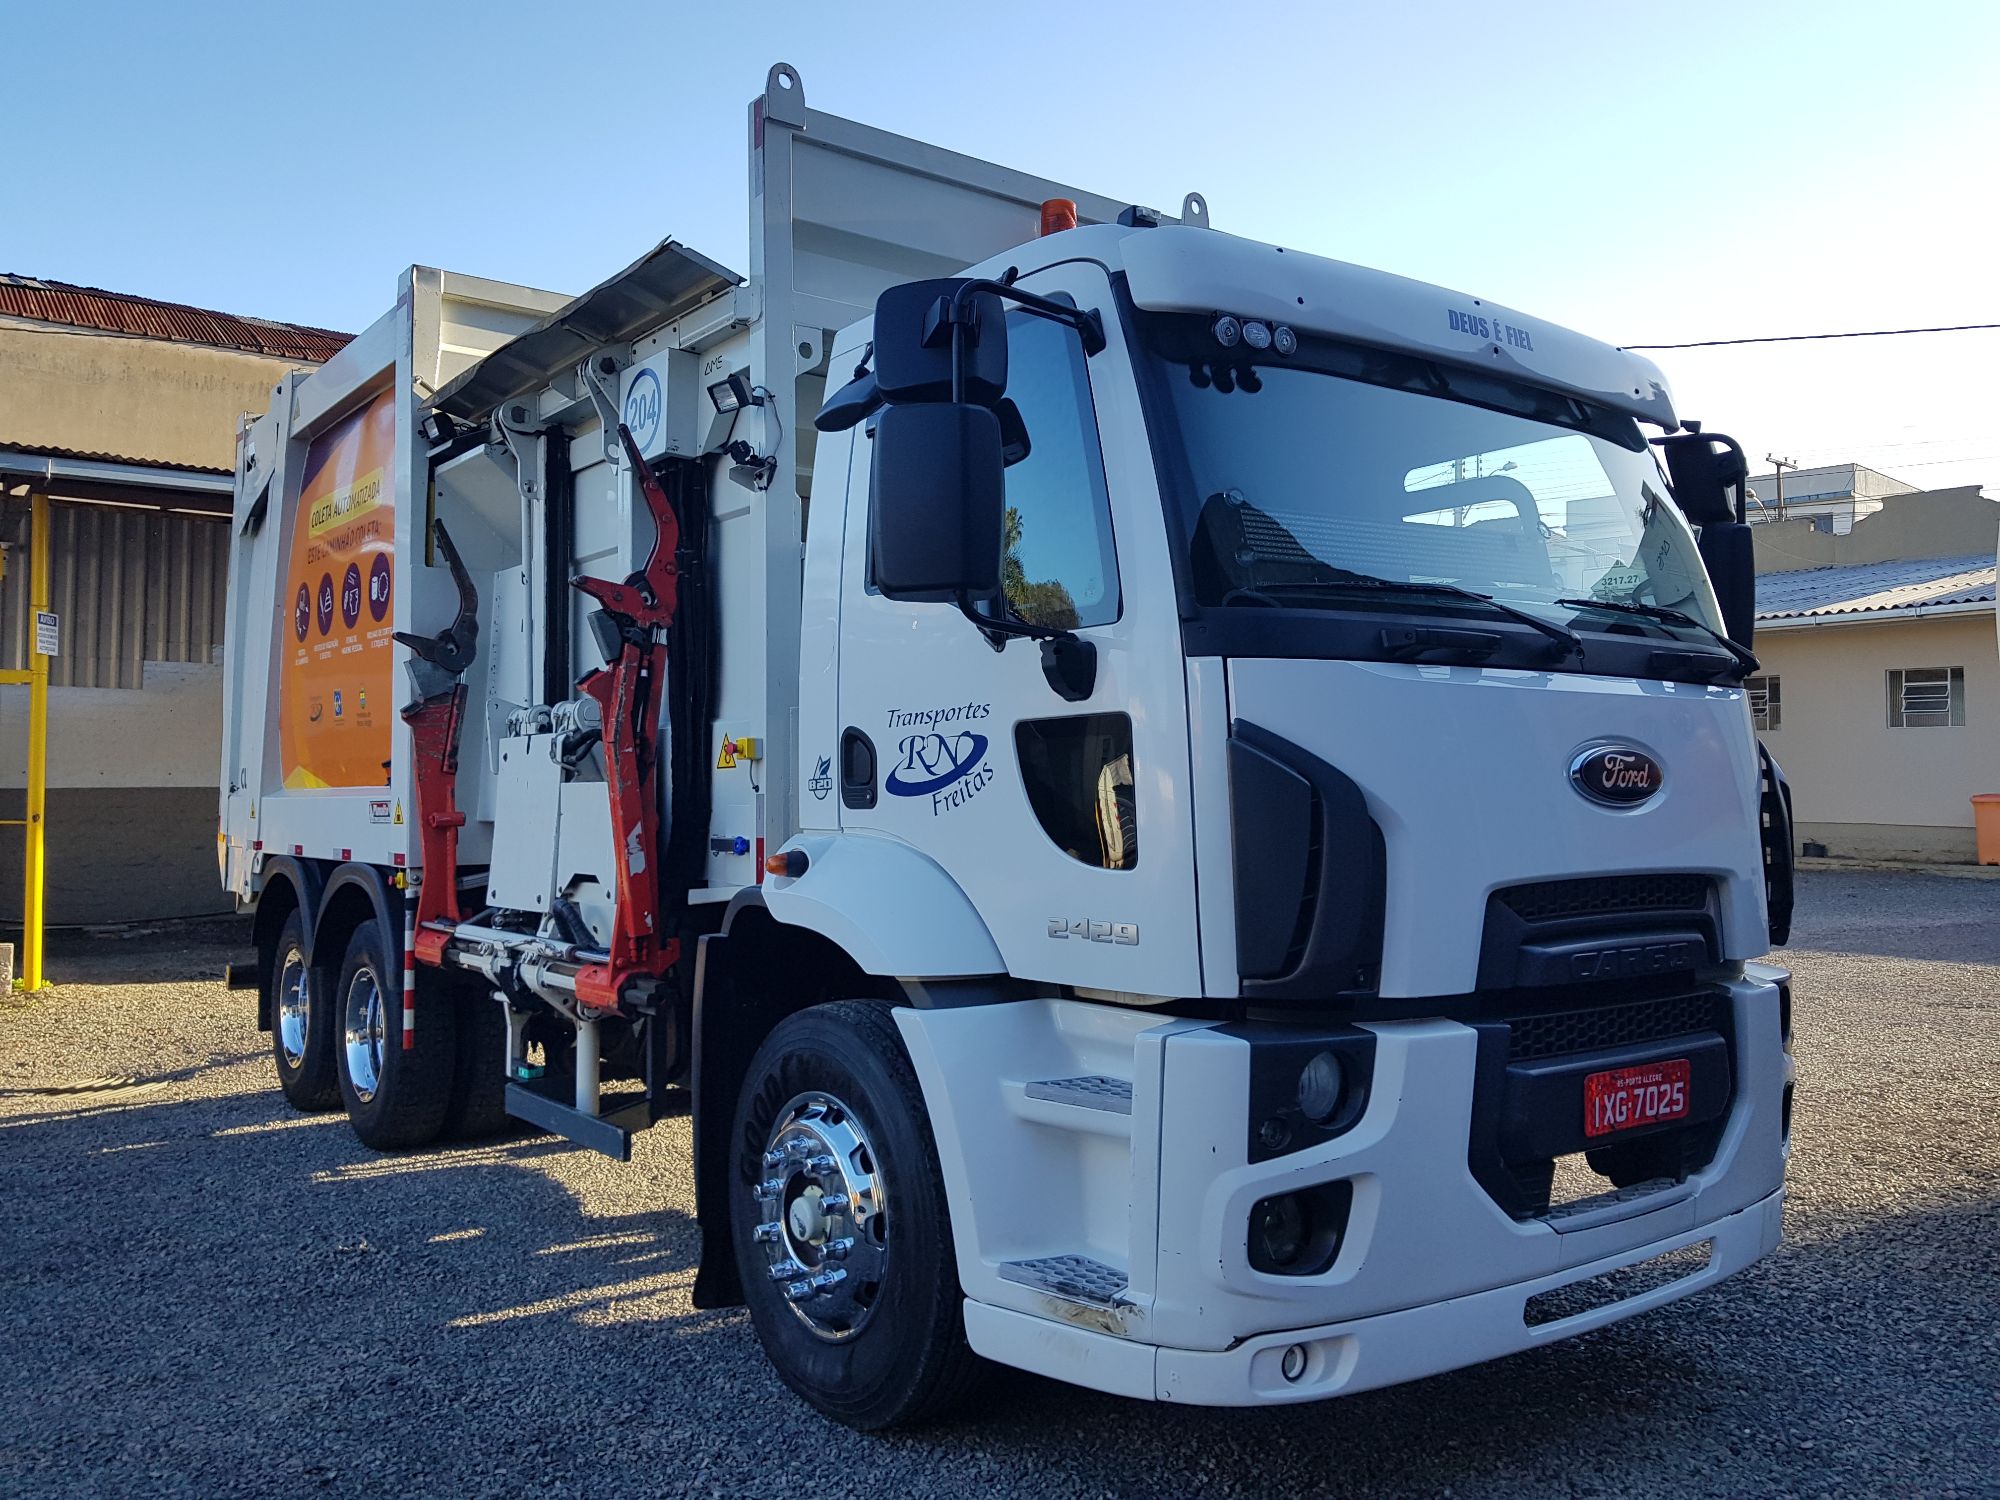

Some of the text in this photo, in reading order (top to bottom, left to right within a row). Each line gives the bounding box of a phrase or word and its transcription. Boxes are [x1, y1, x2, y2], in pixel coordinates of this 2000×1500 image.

[1447, 308, 1534, 352] DEUS É FIEL
[629, 388, 657, 434] 204
[311, 479, 380, 528] COLETA AUTOMATIZADA
[887, 701, 991, 731] Transportes
[932, 761, 994, 817] Freitas
[1602, 753, 1651, 788] Ford
[1047, 917, 1140, 946] 2429
